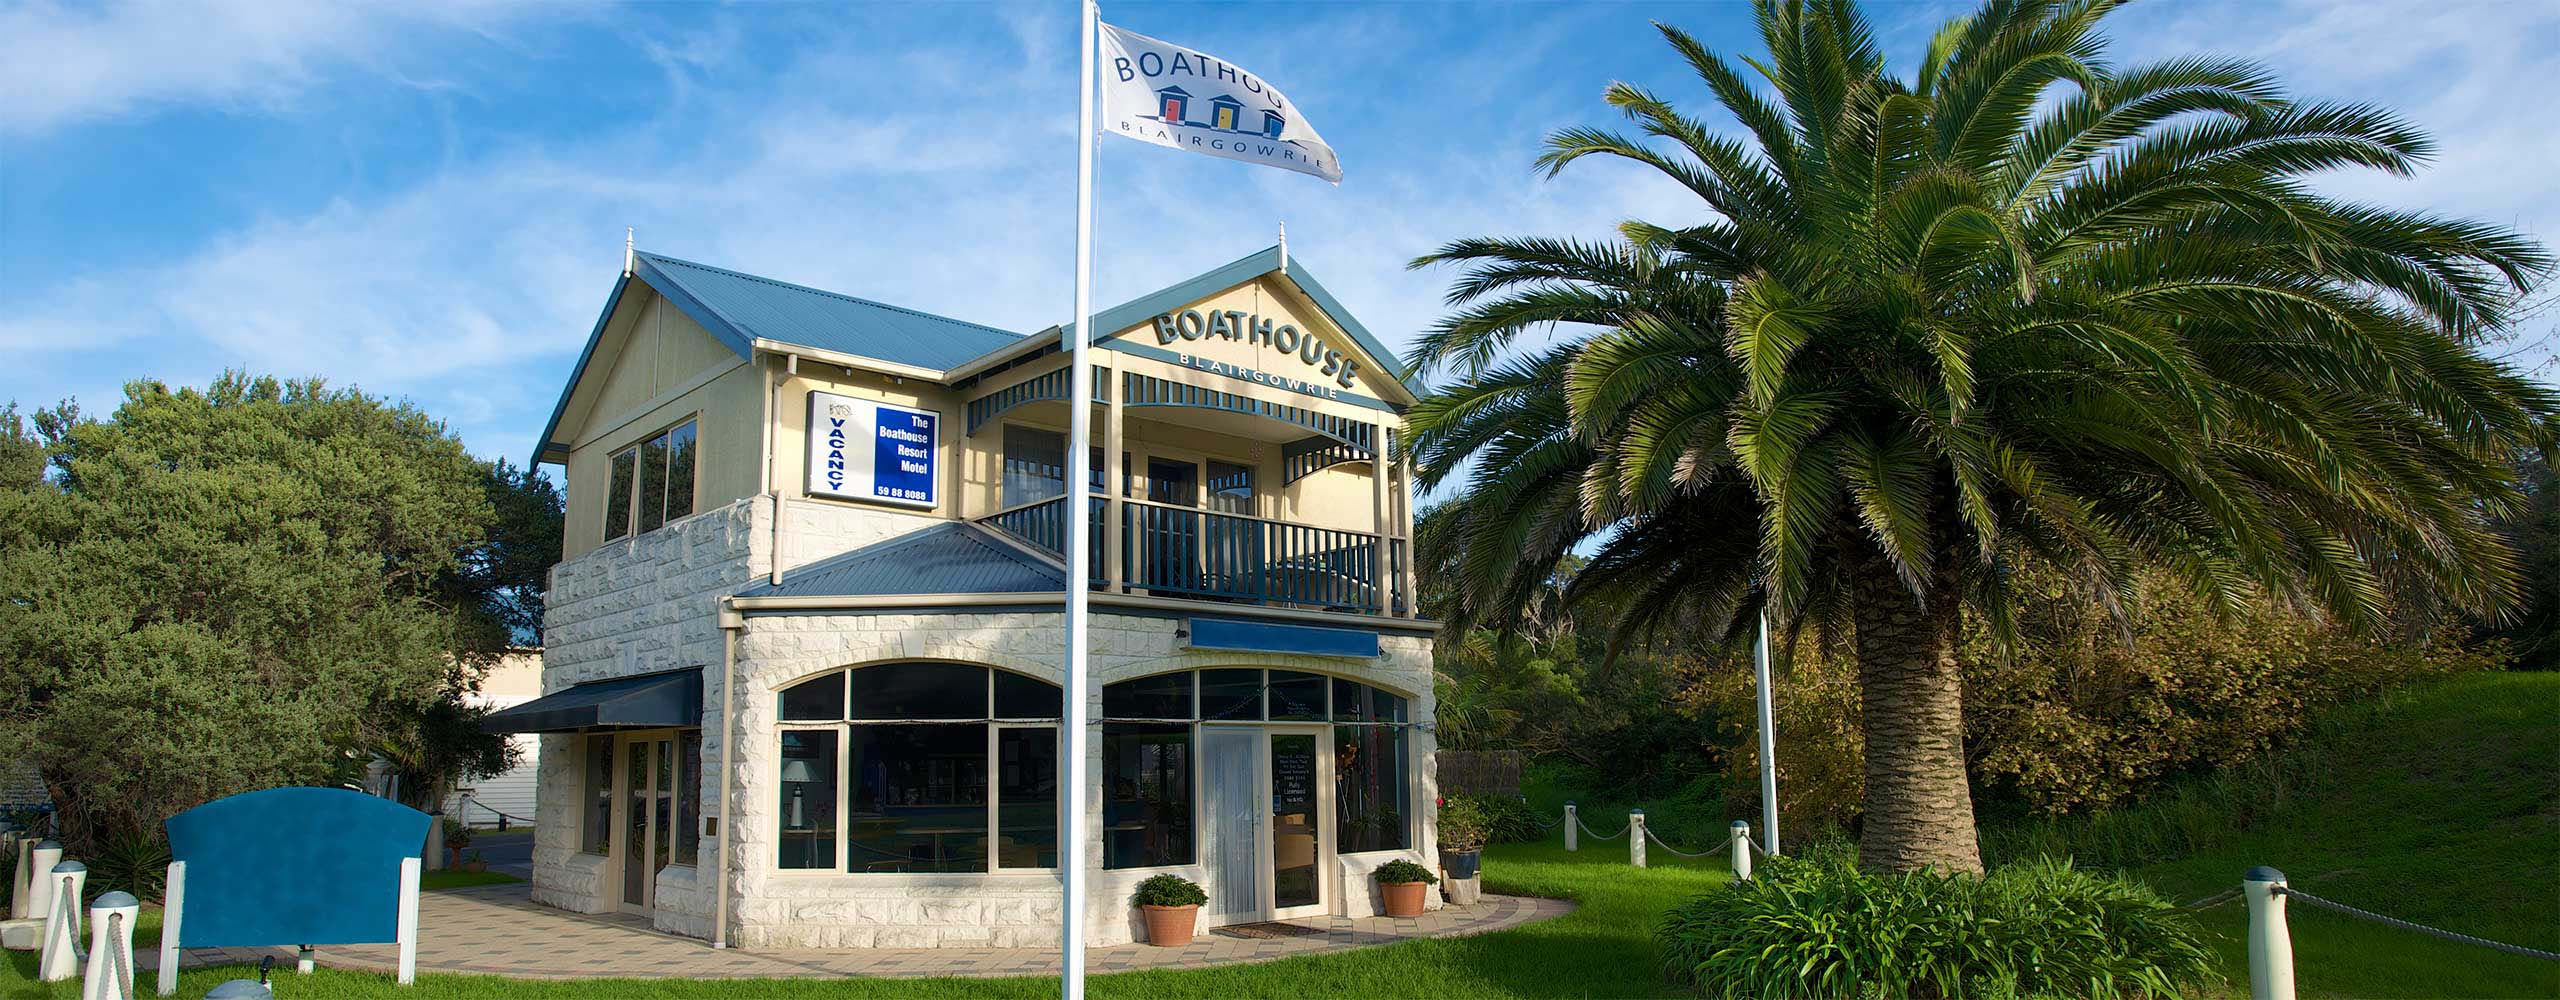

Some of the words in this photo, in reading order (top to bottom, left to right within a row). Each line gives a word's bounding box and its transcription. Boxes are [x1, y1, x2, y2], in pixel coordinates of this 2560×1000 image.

[1121, 120, 1324, 169] BLAIRGOWRIE
[1151, 309, 1361, 389] BOATHOUSE
[1179, 353, 1337, 399] BLAIRGOWRIE
[912, 415, 928, 429] The
[880, 425, 928, 443] Boathouse
[828, 417, 845, 491] VACANCY
[898, 444, 928, 459] Resort
[901, 460, 928, 474] Motel
[878, 486, 889, 496] 59
[891, 487, 902, 497] 88
[905, 489, 926, 500] 8088
